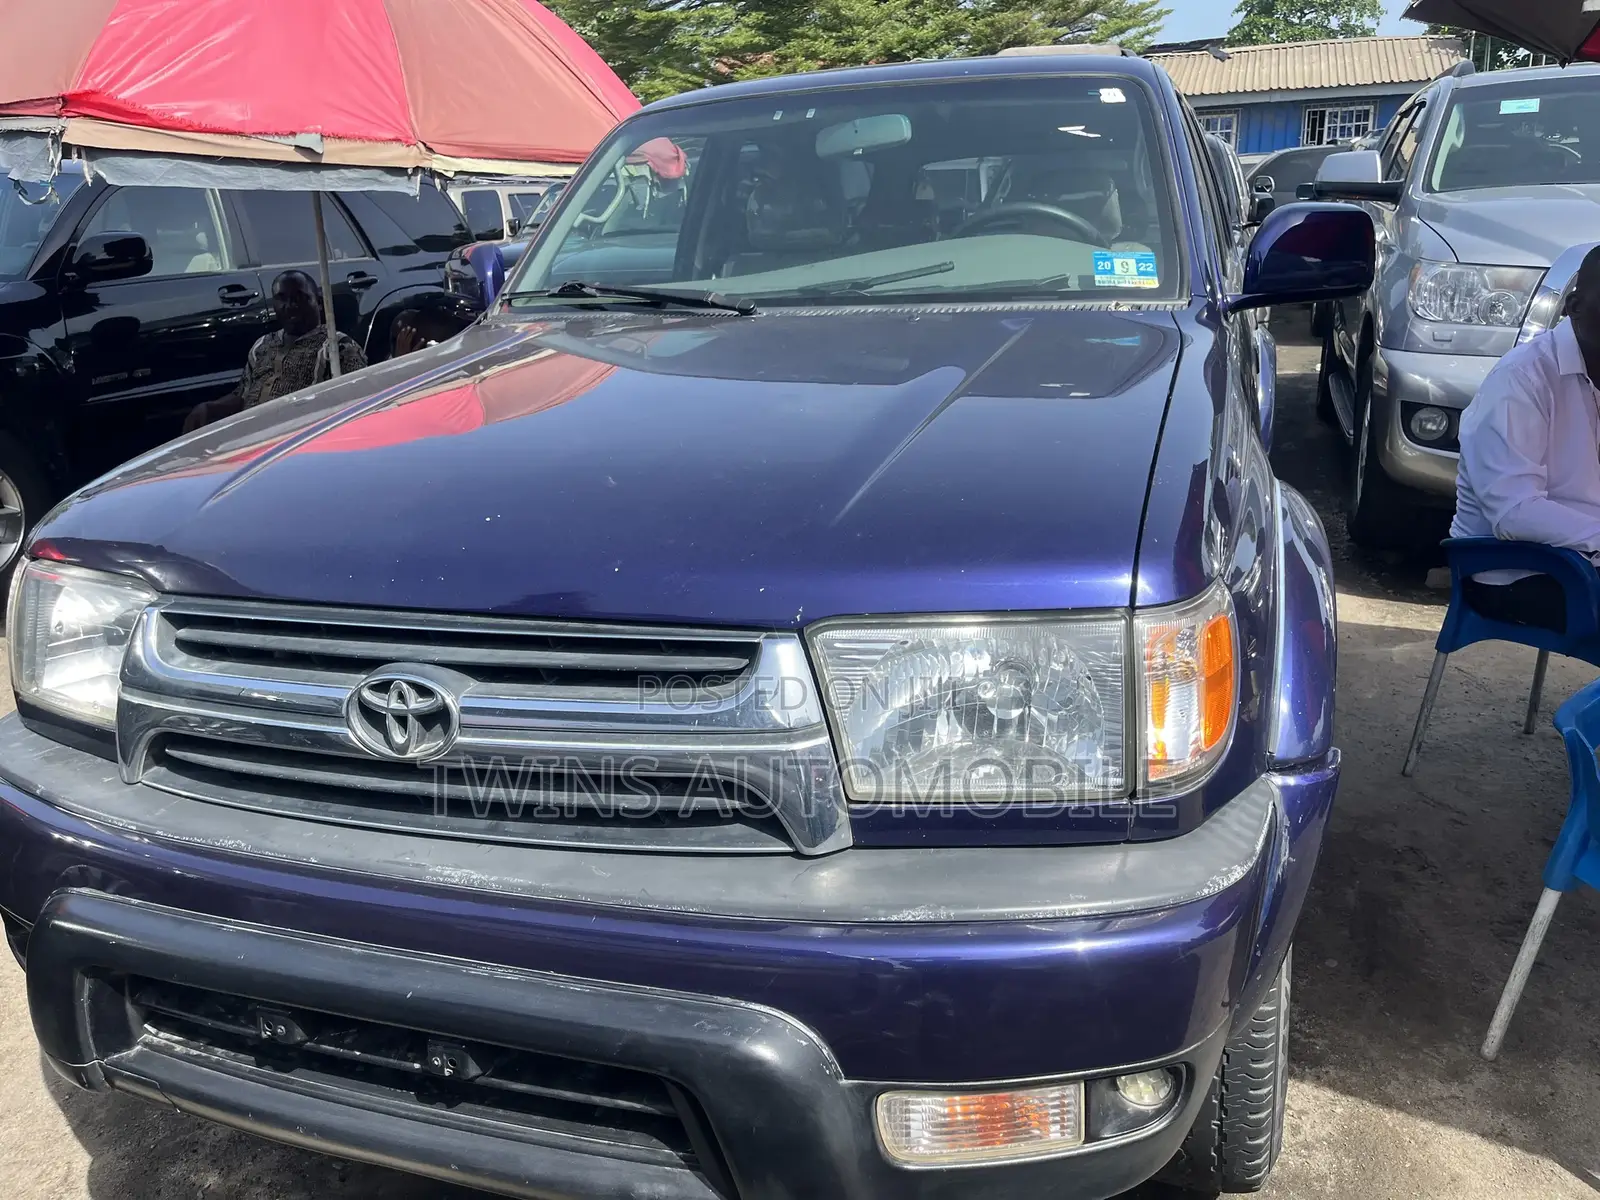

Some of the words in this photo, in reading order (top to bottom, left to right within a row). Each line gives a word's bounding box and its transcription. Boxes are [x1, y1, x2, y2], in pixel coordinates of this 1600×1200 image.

[1097, 261, 1111, 270] 20
[1120, 260, 1129, 274] 9
[1138, 262, 1154, 272] 22
